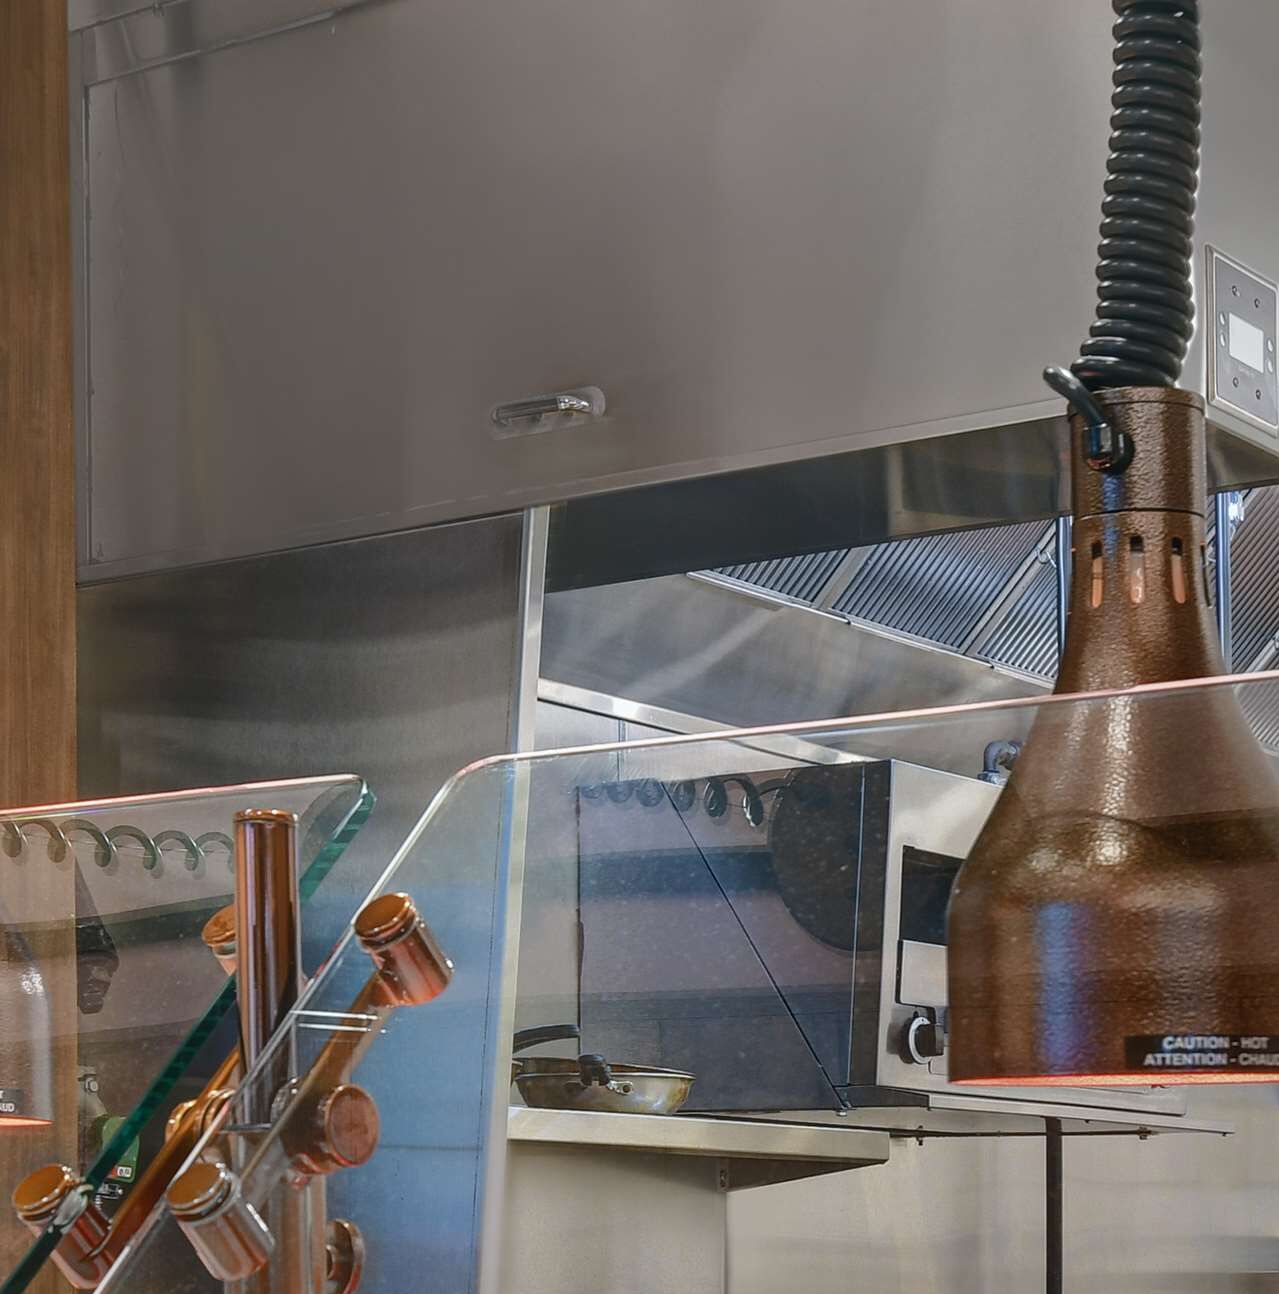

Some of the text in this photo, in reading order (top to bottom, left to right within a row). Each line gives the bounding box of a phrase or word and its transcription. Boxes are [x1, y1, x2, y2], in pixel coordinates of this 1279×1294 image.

[1162, 1036, 1230, 1050] CAUTION
[1240, 1037, 1269, 1049] HOT
[1144, 1053, 1228, 1066] ATTENTION
